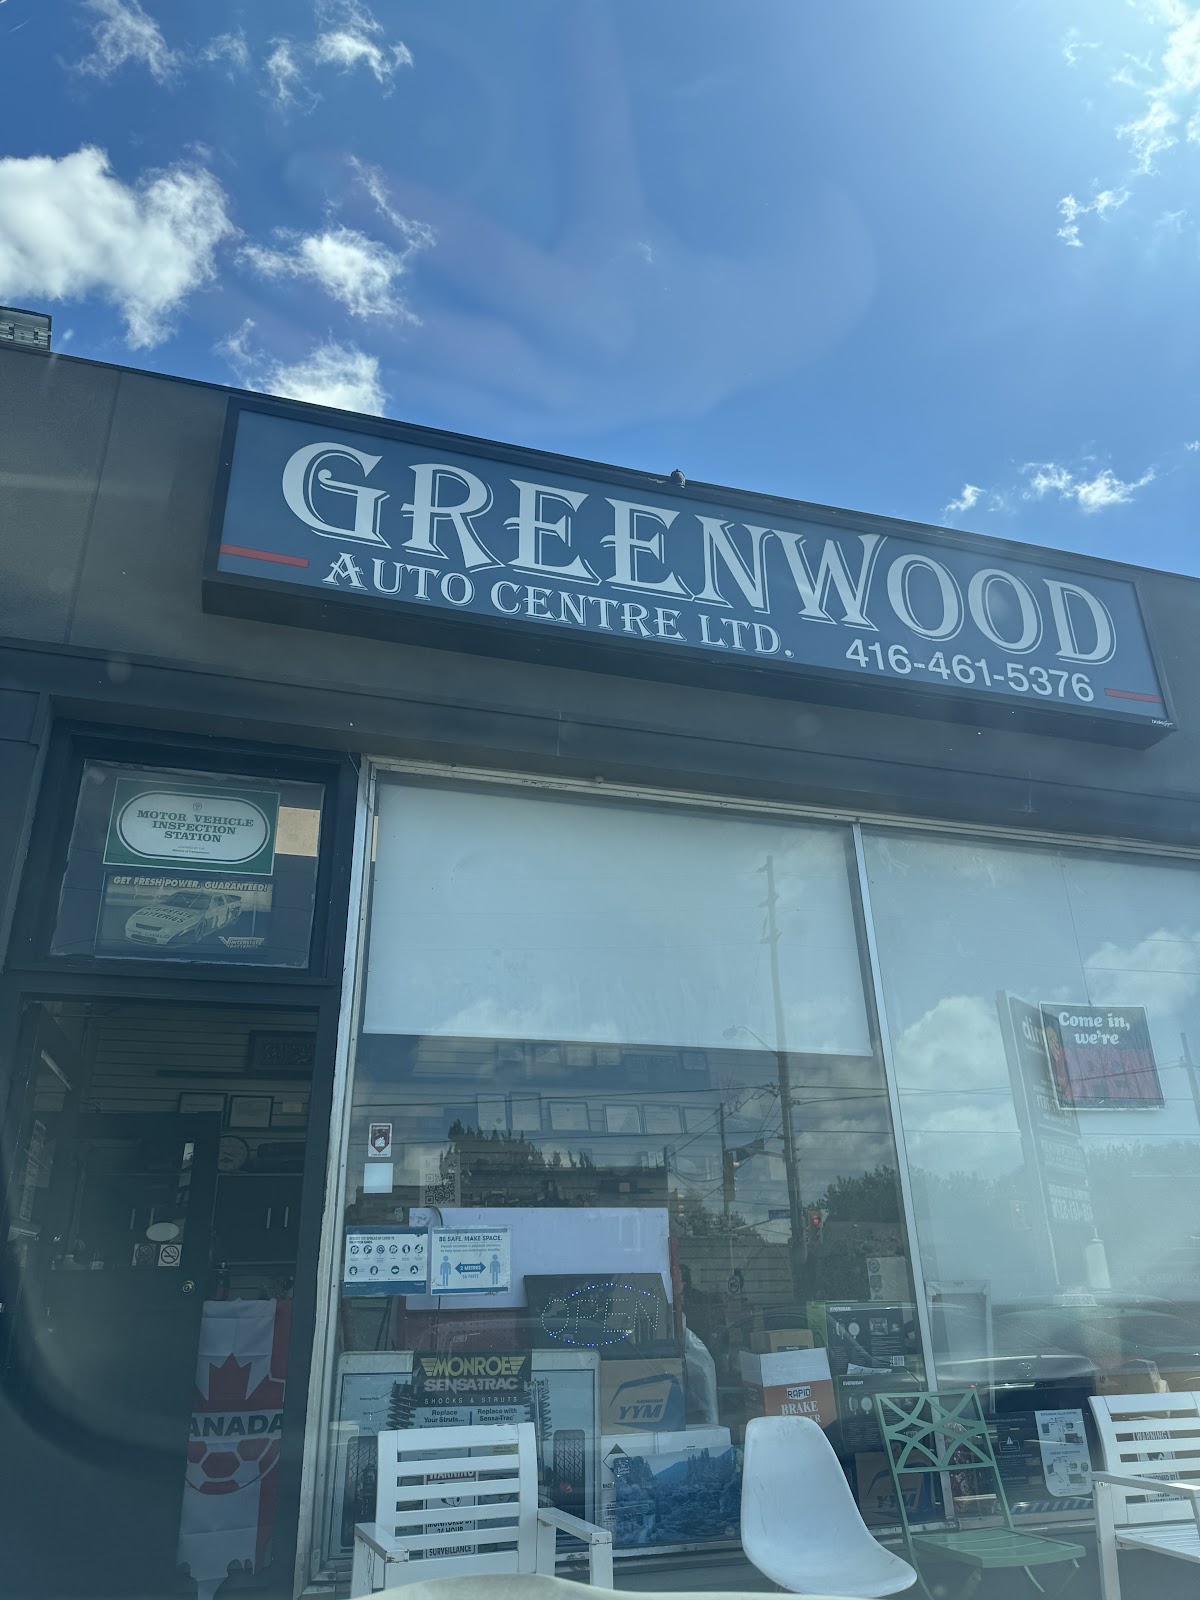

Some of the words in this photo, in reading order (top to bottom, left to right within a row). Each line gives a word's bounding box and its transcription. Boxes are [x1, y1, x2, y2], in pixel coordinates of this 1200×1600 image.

[282, 442, 1117, 665] GREENWOOD
[322, 552, 475, 606] AUTO
[490, 581, 688, 642] CENTRE
[698, 613, 795, 658] LTD.
[846, 639, 1095, 702] 416-461-5376
[136, 809, 187, 822] MOTOR
[194, 814, 254, 828] VEHICLE
[152, 820, 237, 835] INSPECTION
[164, 831, 222, 843] STATION
[113, 876, 132, 885] GET
[133, 877, 163, 887] FRESH
[164, 879, 201, 889] POWER.
[204, 881, 268, 892] GUARANTEED!
[1058, 1011, 1103, 1028] Come
[1107, 1013, 1131, 1031] in,
[1074, 1030, 1120, 1045] we're
[541, 1297, 660, 1335] OPEN
[432, 1356, 512, 1377] MONROE
[424, 1397, 463, 1405] SHOCKS
[787, 1388, 811, 1398] RAPID
[431, 1409, 458, 1417] Replace
[477, 1408, 503, 1416] Replace
[619, 1404, 663, 1420] YYM
[780, 1400, 819, 1416] BRAKE
[189, 1413, 282, 1437] ANADA
[1136, 1430, 1168, 1441] WARNING
[429, 1545, 472, 1556] SURVEILLANCE
